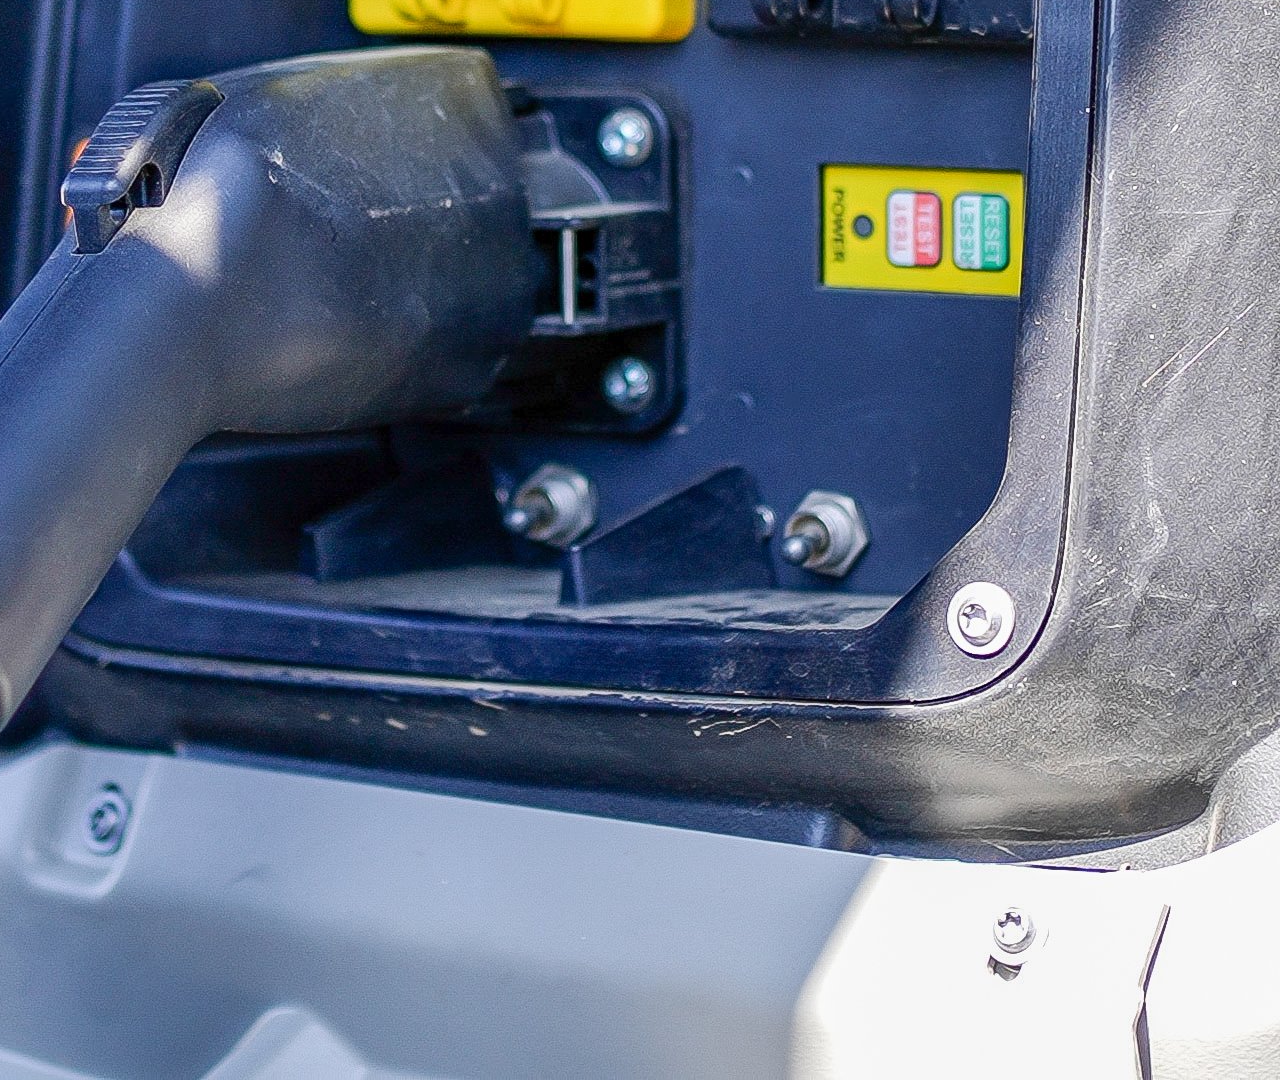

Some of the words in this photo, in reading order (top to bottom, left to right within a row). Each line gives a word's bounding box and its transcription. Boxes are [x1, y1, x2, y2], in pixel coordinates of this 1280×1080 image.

[832, 188, 846, 262] POWER
[960, 200, 974, 266] RESET
[984, 198, 1002, 266] RESET
